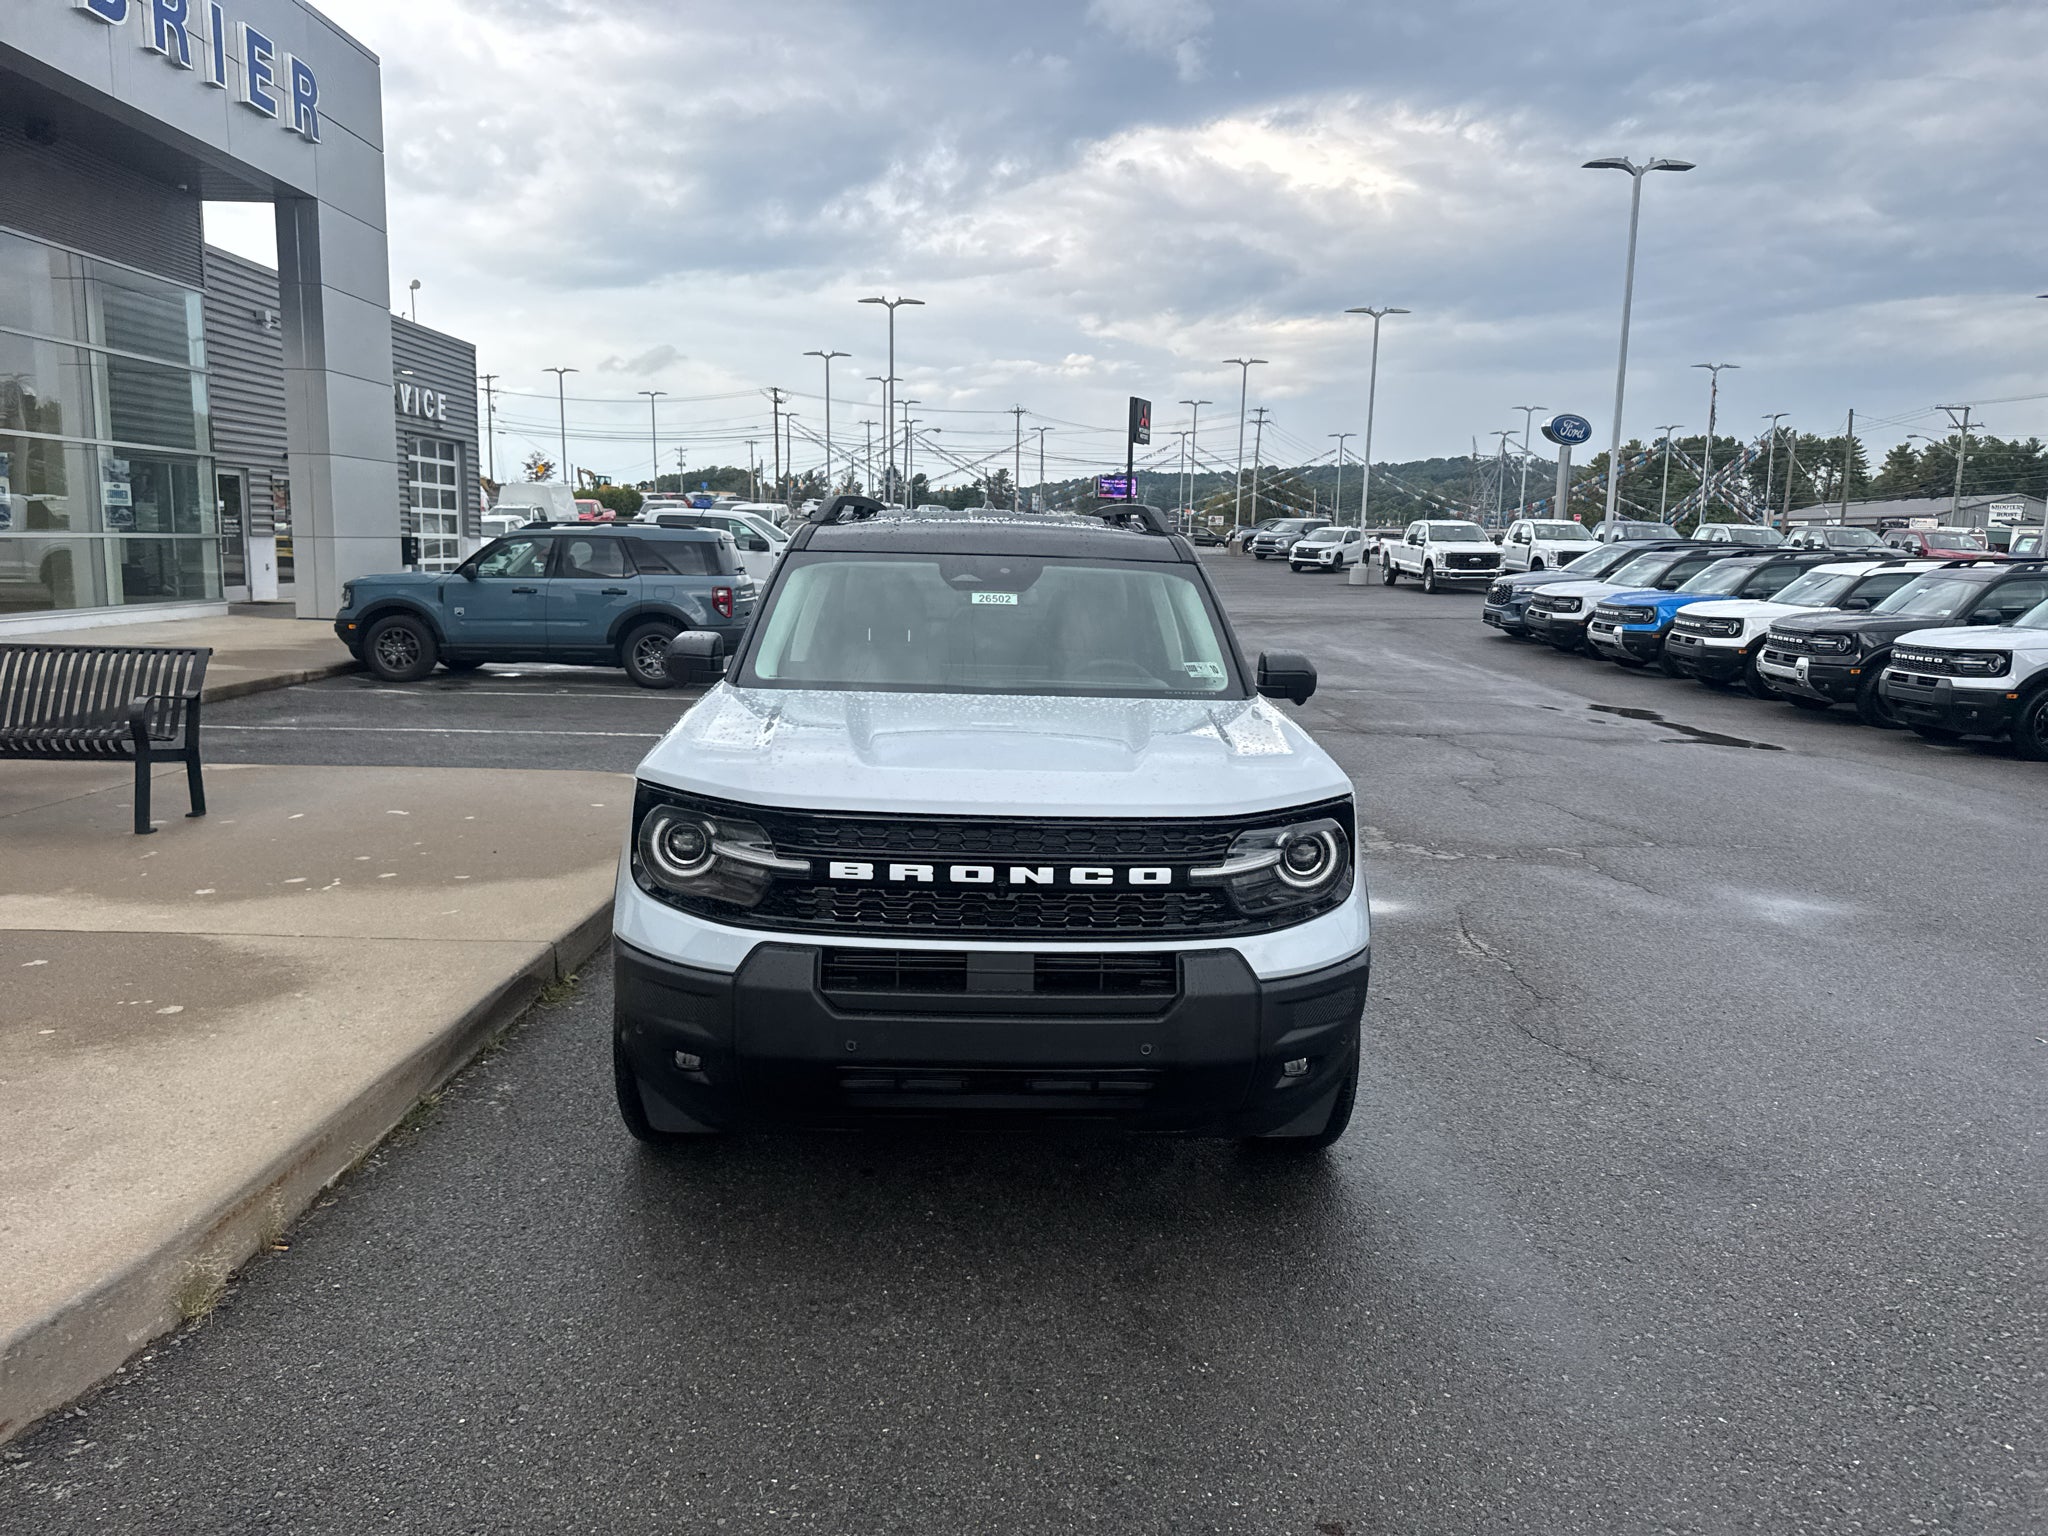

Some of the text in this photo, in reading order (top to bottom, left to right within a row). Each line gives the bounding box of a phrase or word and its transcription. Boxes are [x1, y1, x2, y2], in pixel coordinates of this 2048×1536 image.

[72, 0, 321, 144] RIER
[393, 382, 447, 421] VICE
[1560, 419, 1586, 439] Ford
[978, 594, 1012, 604] 26502
[1894, 653, 1943, 664] BRONCO
[829, 861, 1172, 885] BRONCO
